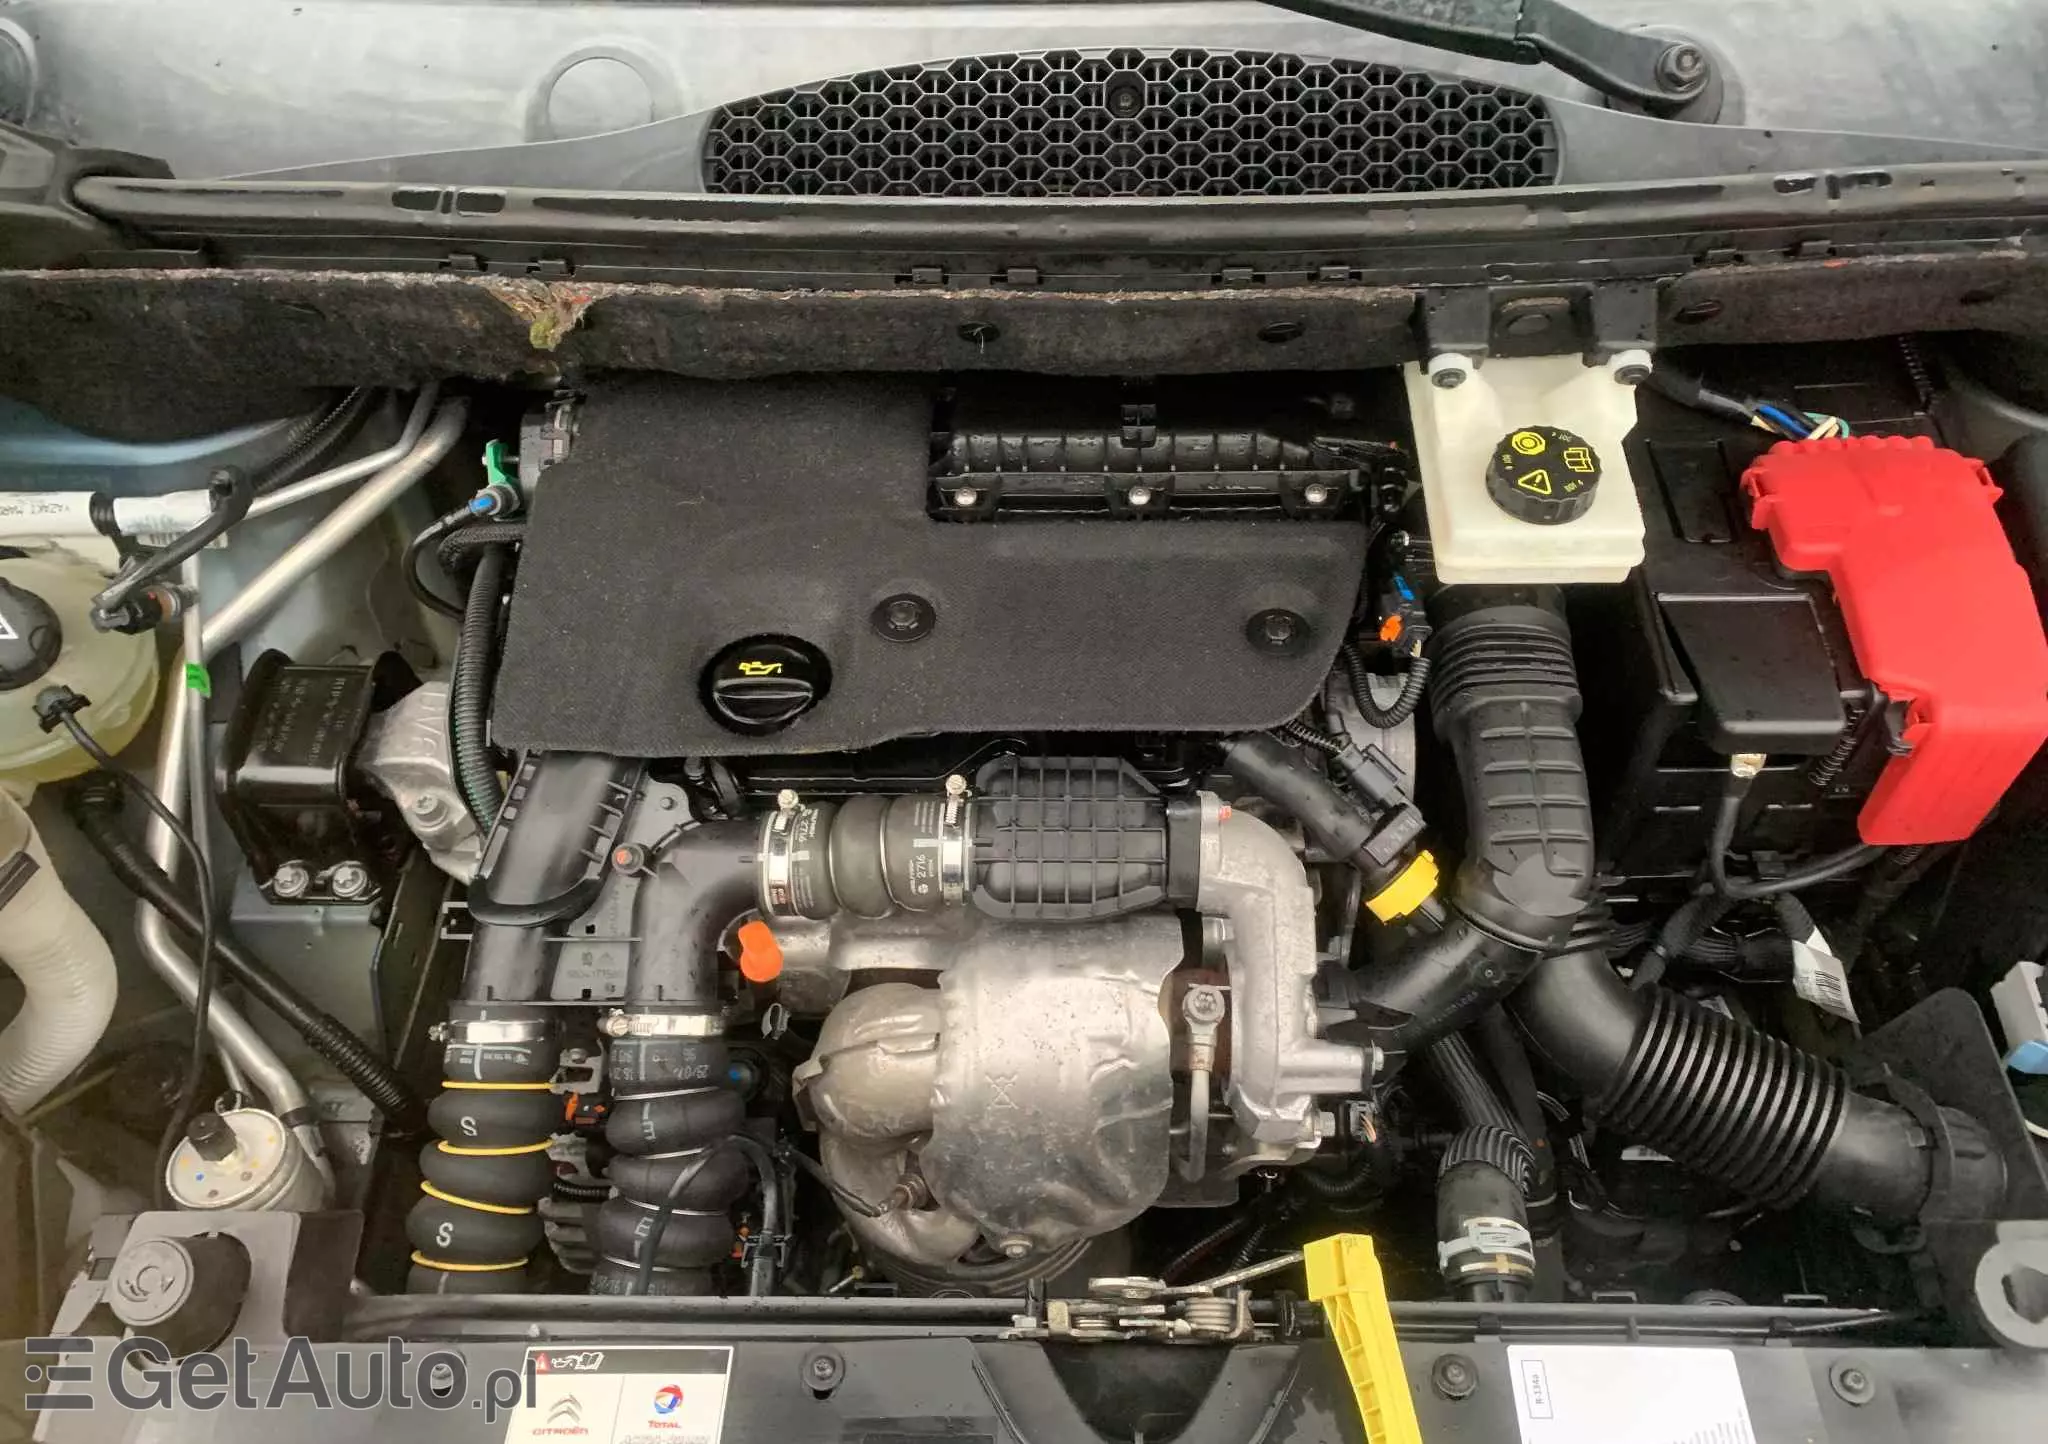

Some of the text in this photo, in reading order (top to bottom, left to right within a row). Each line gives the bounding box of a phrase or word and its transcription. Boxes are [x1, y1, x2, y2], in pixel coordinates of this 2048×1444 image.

[915, 854, 927, 879] 2716
[460, 1116, 477, 1136] S
[436, 1222, 454, 1248] S
[648, 1420, 681, 1429] TOTAL
